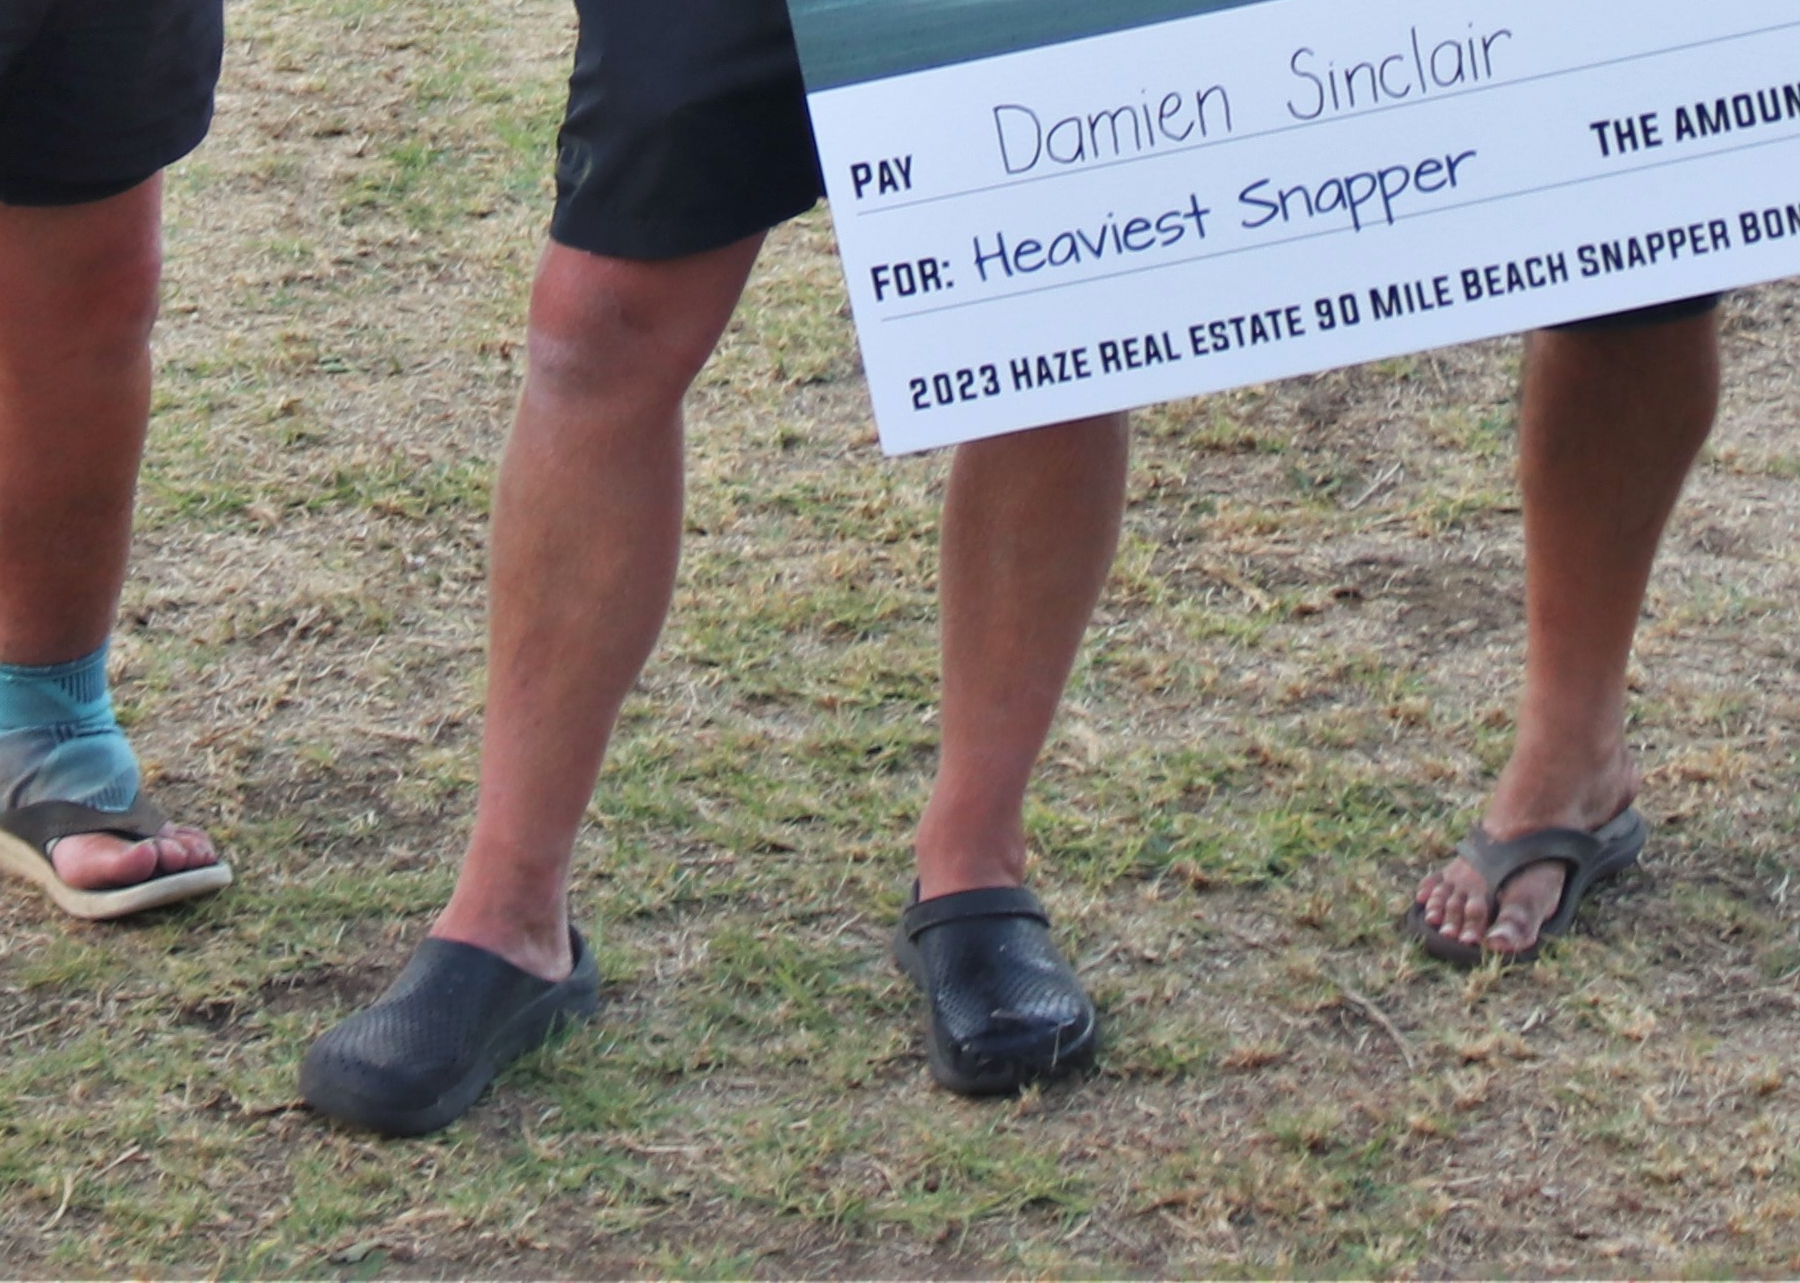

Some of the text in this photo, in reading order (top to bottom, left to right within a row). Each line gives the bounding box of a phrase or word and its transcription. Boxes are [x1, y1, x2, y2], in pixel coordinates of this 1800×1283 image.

[850, 21, 1513, 200] PAY Damien Sinclair
[1589, 115, 1663, 158] THE
[870, 147, 1479, 304] FOR: Heaviest Snapper
[909, 362, 1002, 412] 2023
[1009, 347, 1093, 395] HAZE
[1098, 330, 1183, 374] REAL
[1188, 304, 1307, 358] ESTATE
[1313, 291, 1362, 333] 90
[1369, 273, 1455, 321] MILE
[1460, 253, 1570, 304] BEACH
[1578, 218, 1733, 282] SNAPPER
